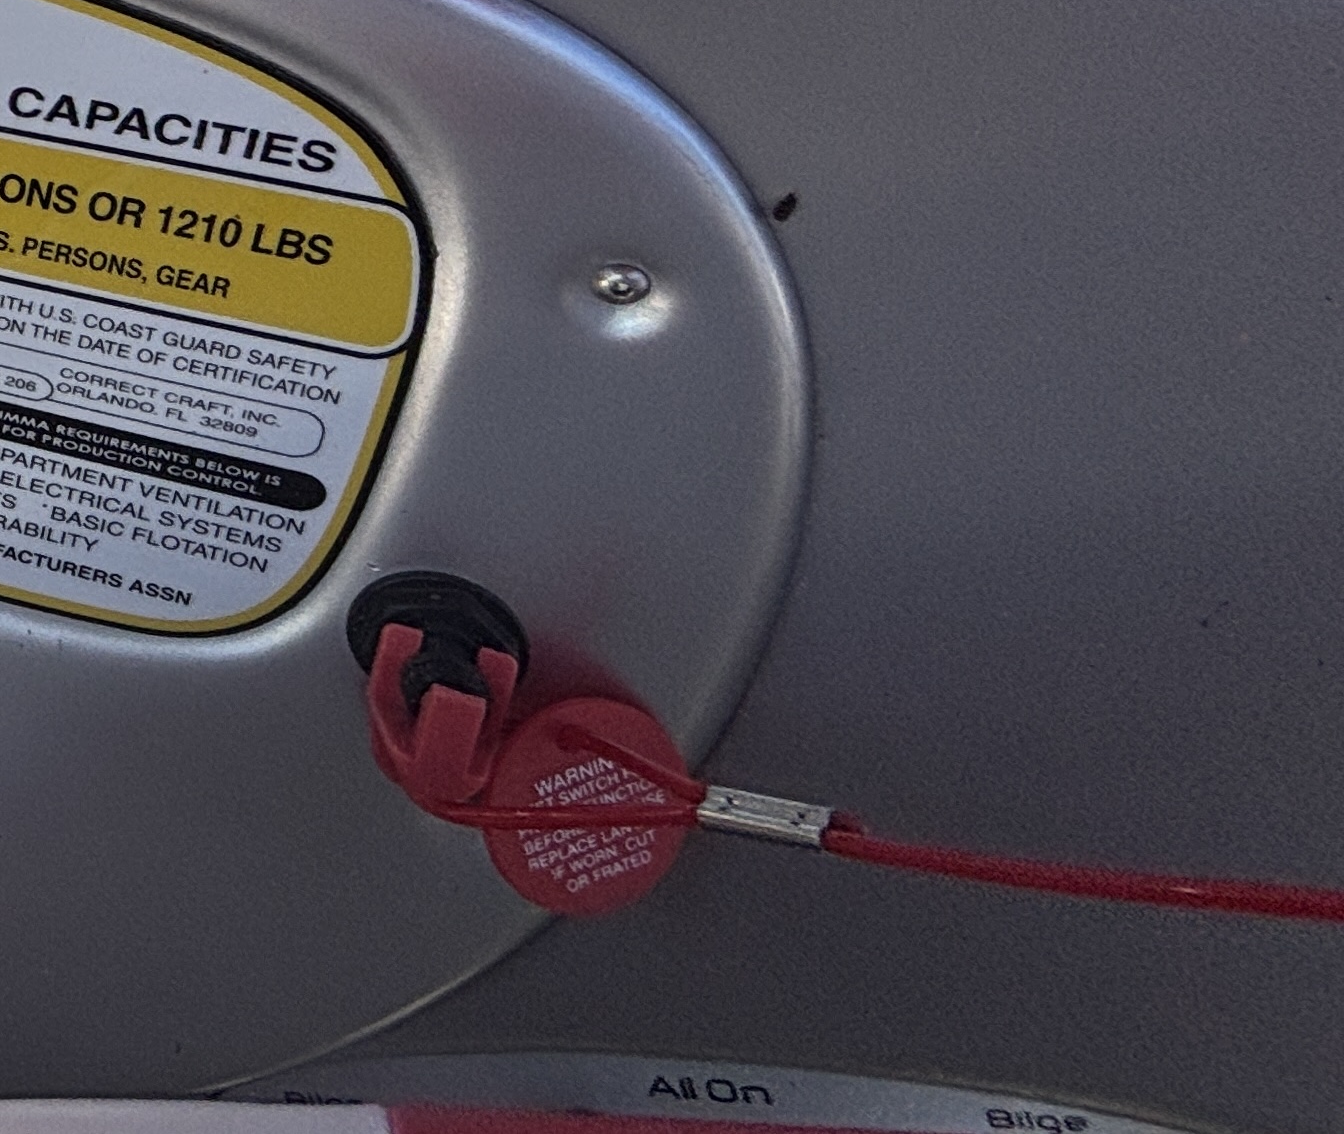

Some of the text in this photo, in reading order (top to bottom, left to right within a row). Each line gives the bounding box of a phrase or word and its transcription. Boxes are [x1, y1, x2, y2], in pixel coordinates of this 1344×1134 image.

[8, 86, 336, 172] CAPACITIES
[88, 191, 146, 228] OR
[158, 205, 242, 247] 1210
[250, 223, 333, 265] LBS
[156, 264, 230, 298] GEAR
[31, 323, 71, 345] THE
[77, 334, 131, 358] DATE
[136, 348, 167, 365] OF
[172, 355, 340, 404] CERTIFICATION
[82, 313, 157, 341] COAST
[162, 331, 241, 359] GUARD
[246, 349, 336, 380] SAFETY
[4, 375, 36, 391] 206
[59, 367, 158, 398] CORRECT
[165, 407, 186, 421] FL
[199, 416, 257, 437] 32809
[1, 423, 37, 441] FOR
[41, 433, 161, 471] PRODUCTION
[55, 424, 188, 464] REQUIREMENTS
[195, 457, 260, 480] BELOW
[264, 474, 280, 486] IS
[0, 470, 149, 521] ELECTRICAL
[157, 510, 282, 552] SYSTEMS
[139, 481, 305, 535] VENTILATION
[50, 505, 124, 536] BASIC
[131, 526, 268, 573] FLOTATION
[128, 579, 192, 605] ASSN
[534, 757, 613, 797] WARNIN
[648, 1075, 775, 1106] All On
[985, 1107, 1090, 1133] Bilge
